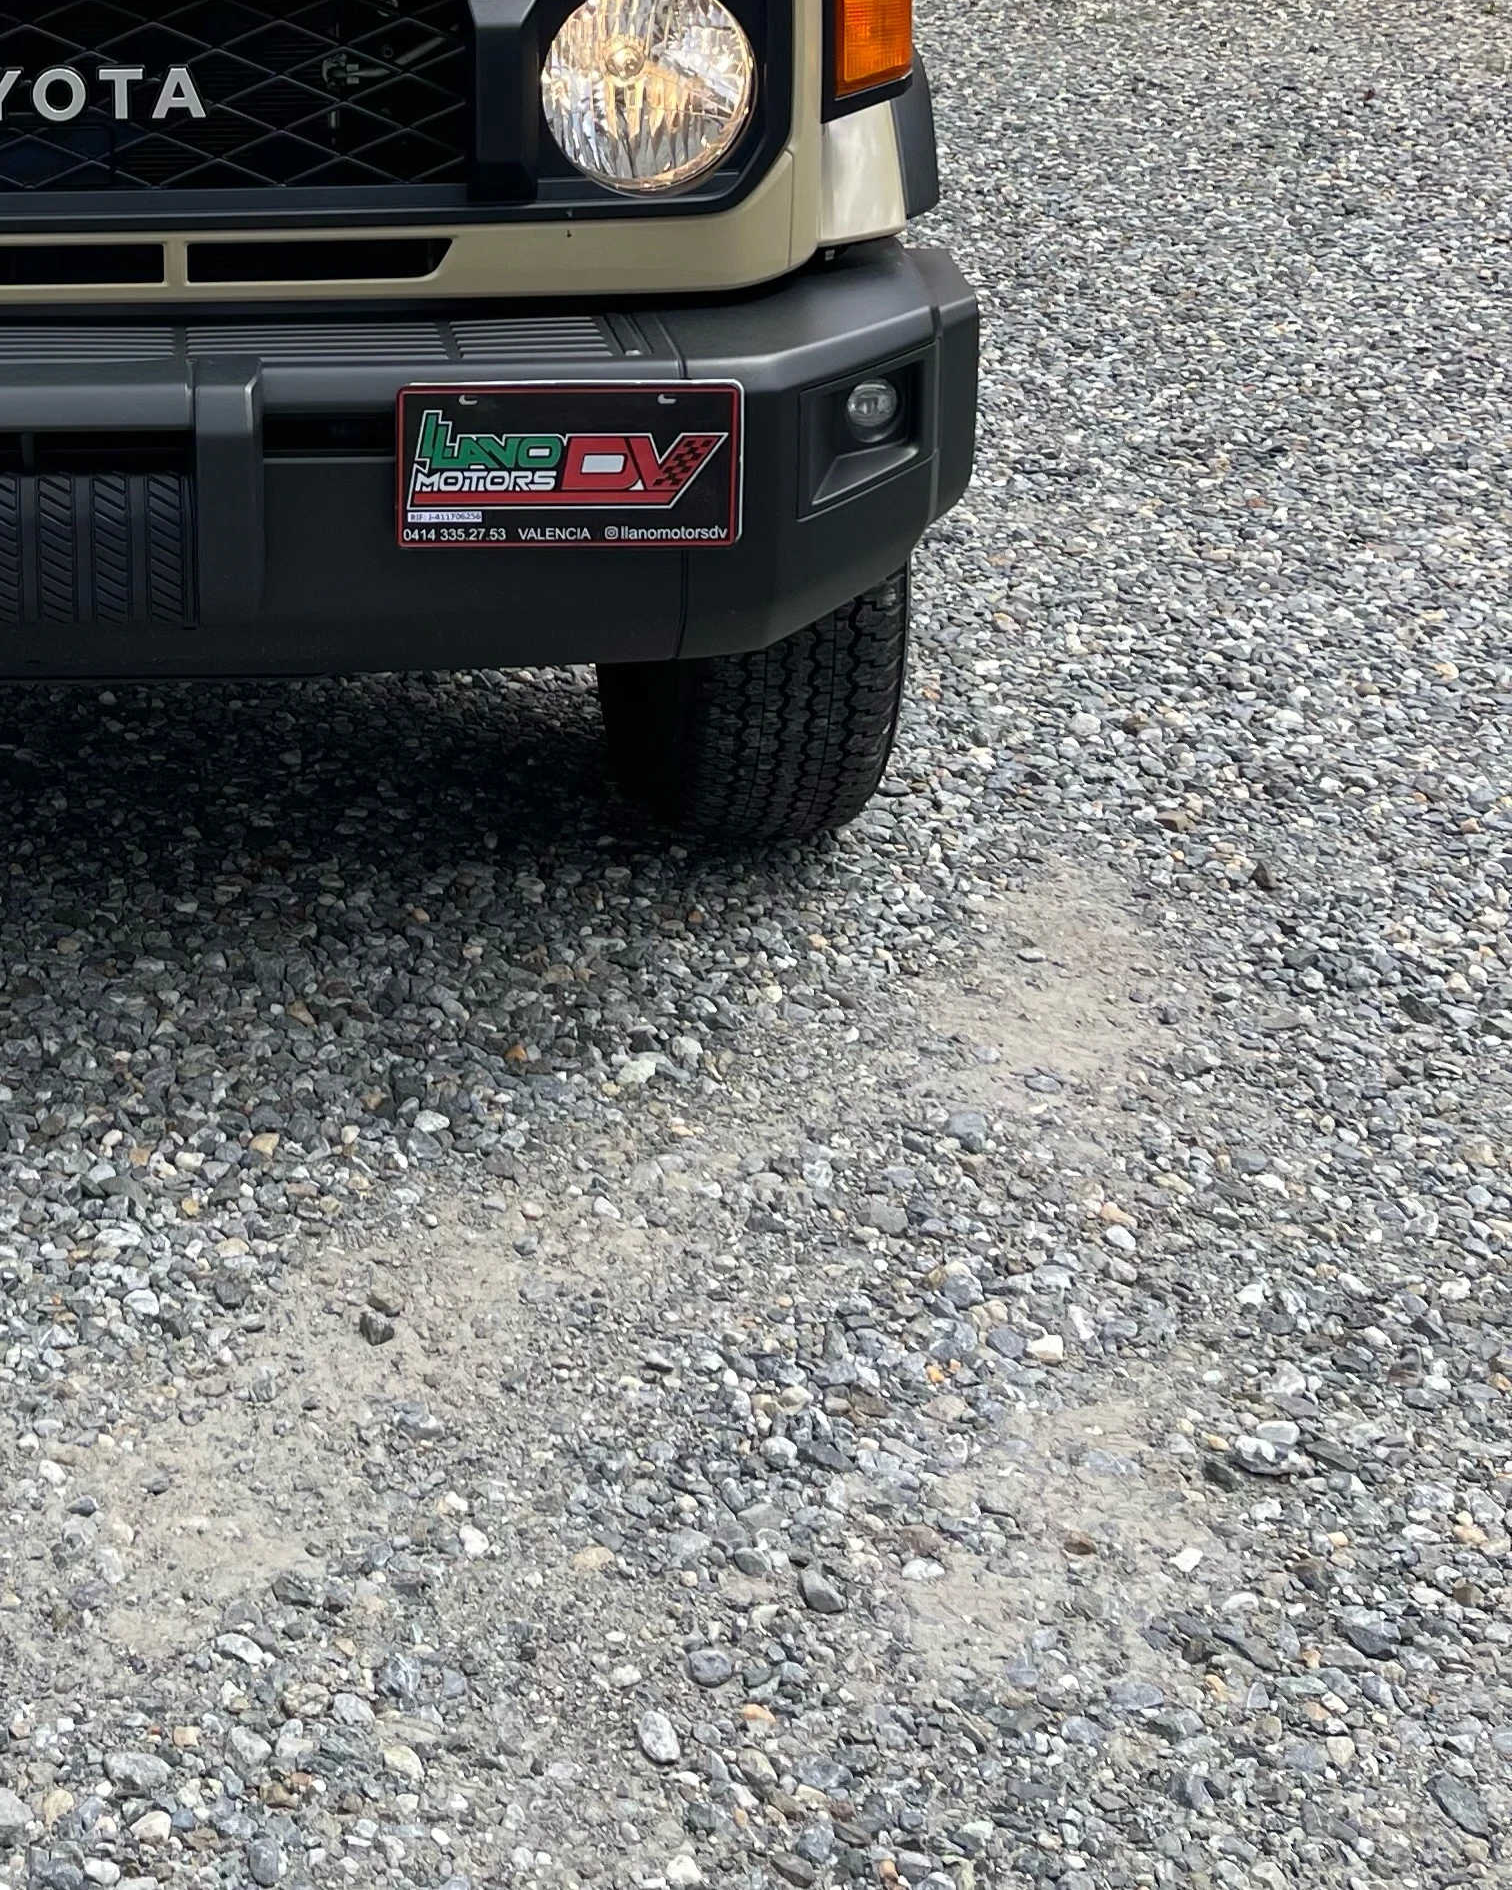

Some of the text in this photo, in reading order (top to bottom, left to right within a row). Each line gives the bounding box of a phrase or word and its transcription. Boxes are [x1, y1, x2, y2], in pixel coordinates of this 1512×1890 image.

[420, 412, 563, 468] LLANO
[414, 470, 558, 492] MOTORS
[561, 436, 724, 490] DV
[403, 525, 728, 541] 0414 335.27.53 VALENCIA llanomotorsdv
